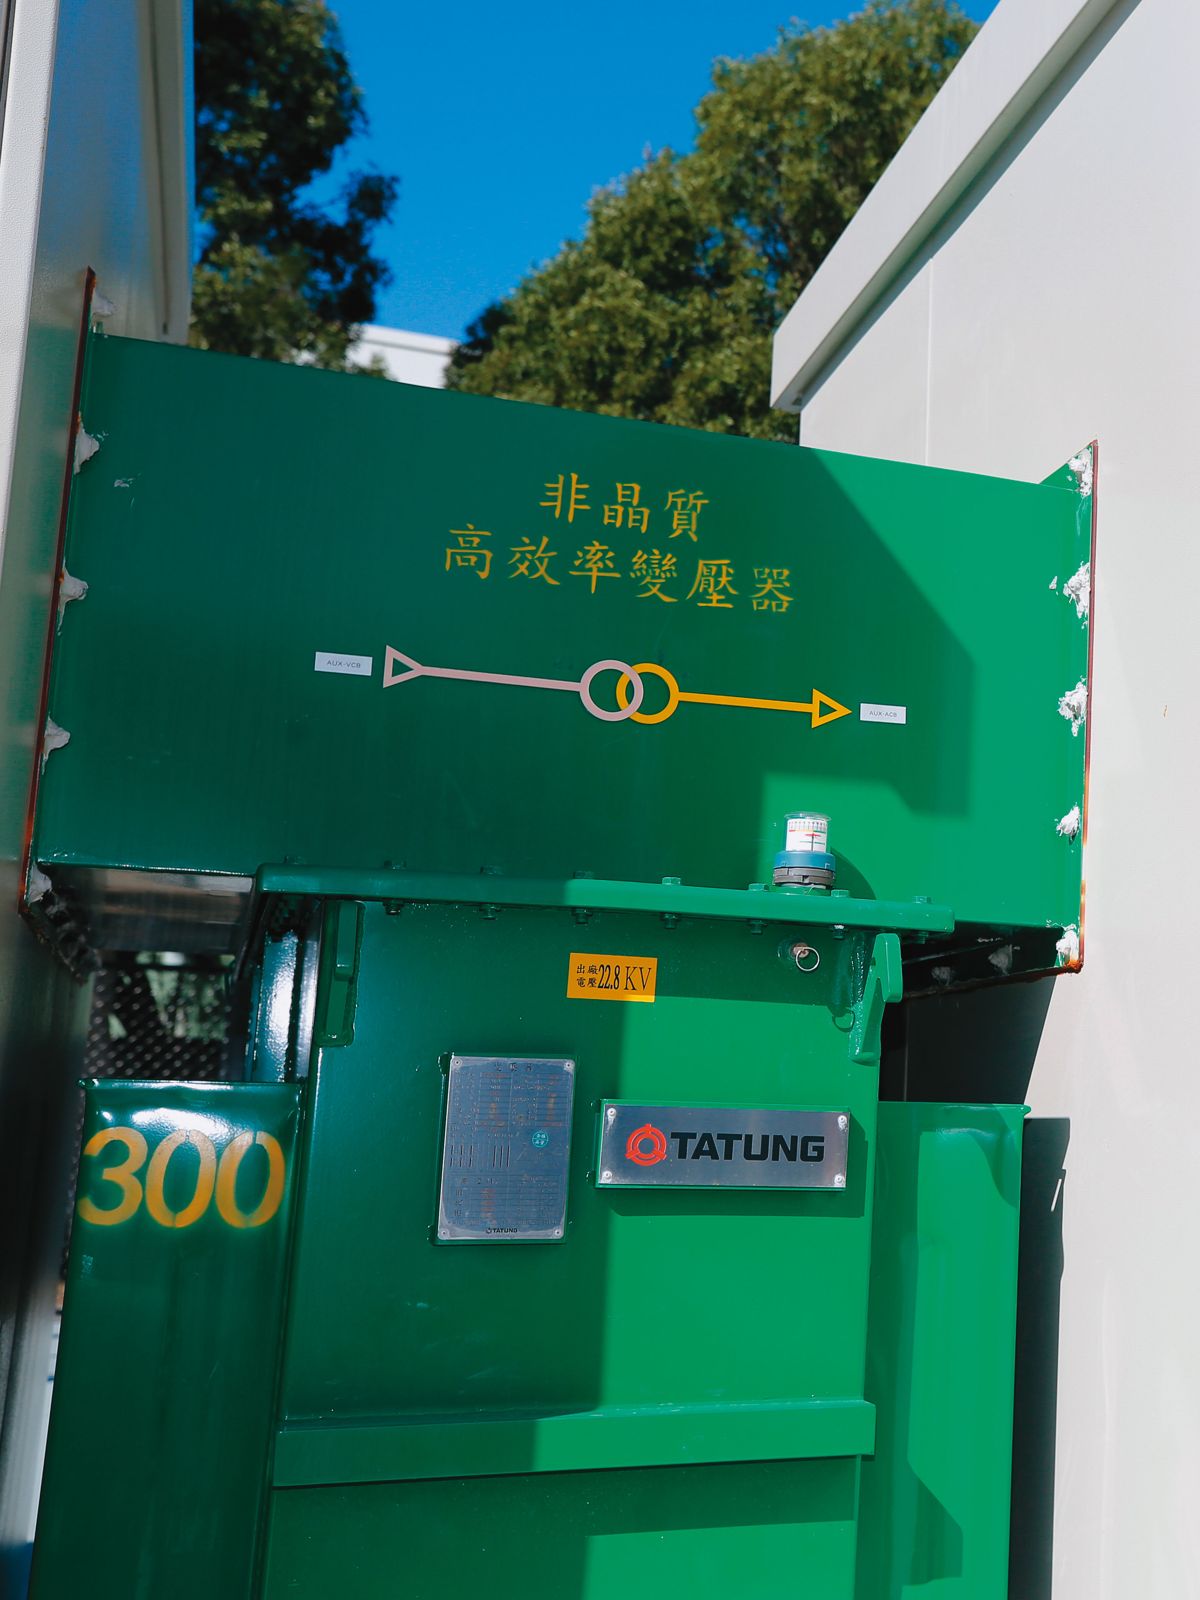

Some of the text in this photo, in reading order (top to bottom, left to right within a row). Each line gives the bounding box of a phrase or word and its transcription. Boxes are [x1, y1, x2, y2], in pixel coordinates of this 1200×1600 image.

[539, 472, 710, 542] 非晶質
[445, 523, 794, 612] 高效率變壓器
[326, 659, 361, 669] AUX-VCB
[869, 710, 897, 718] AUX-ACB
[576, 976, 597, 988] 電壓
[598, 964, 652, 991] 22.8 KV
[670, 1131, 825, 1163] TATUNG
[78, 1126, 285, 1229] 300
